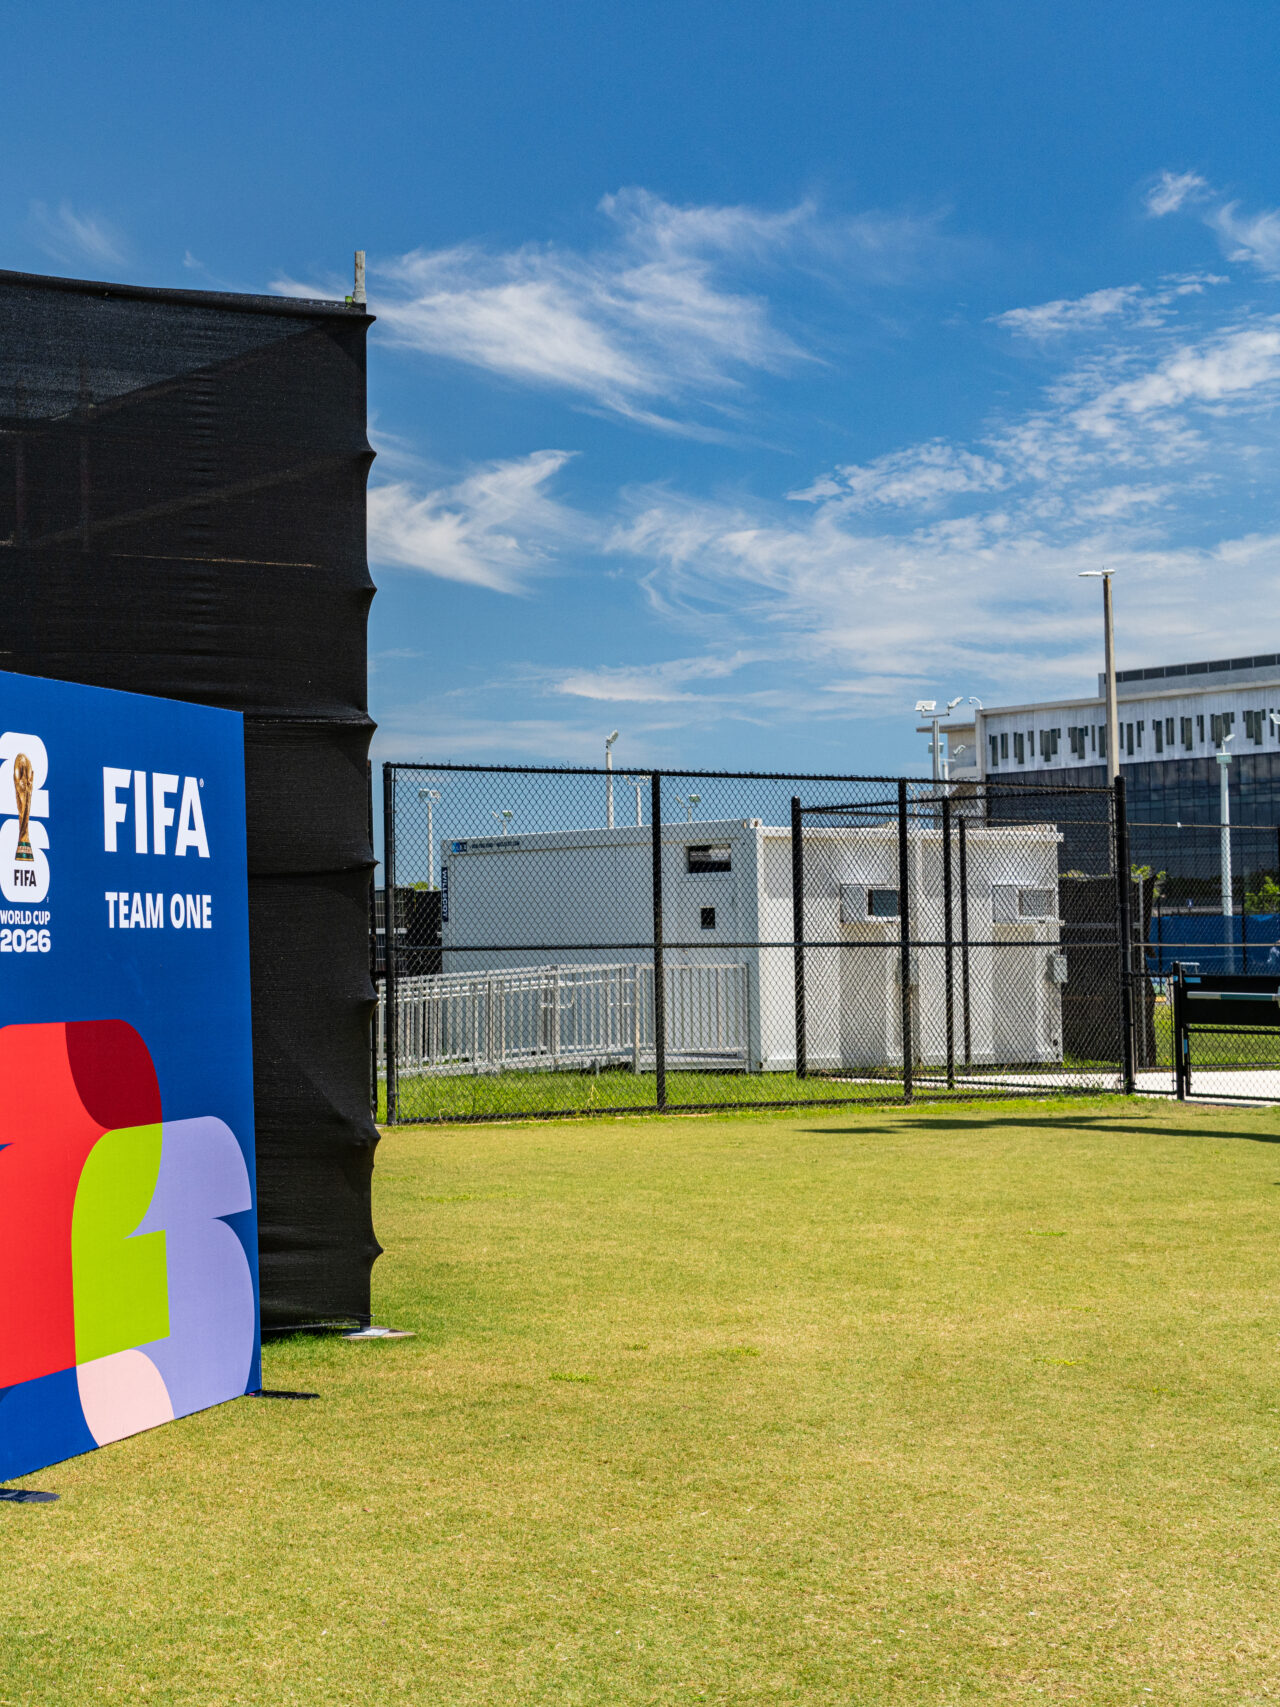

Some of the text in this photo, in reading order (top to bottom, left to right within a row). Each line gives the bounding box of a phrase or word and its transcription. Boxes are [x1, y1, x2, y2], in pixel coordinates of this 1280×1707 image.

[103, 767, 210, 858] FIFA
[14, 870, 36, 886] FIFA
[0, 910, 50, 925] WORLD CUP
[105, 892, 211, 928] TEAM ONE
[0, 929, 51, 952] 2026
